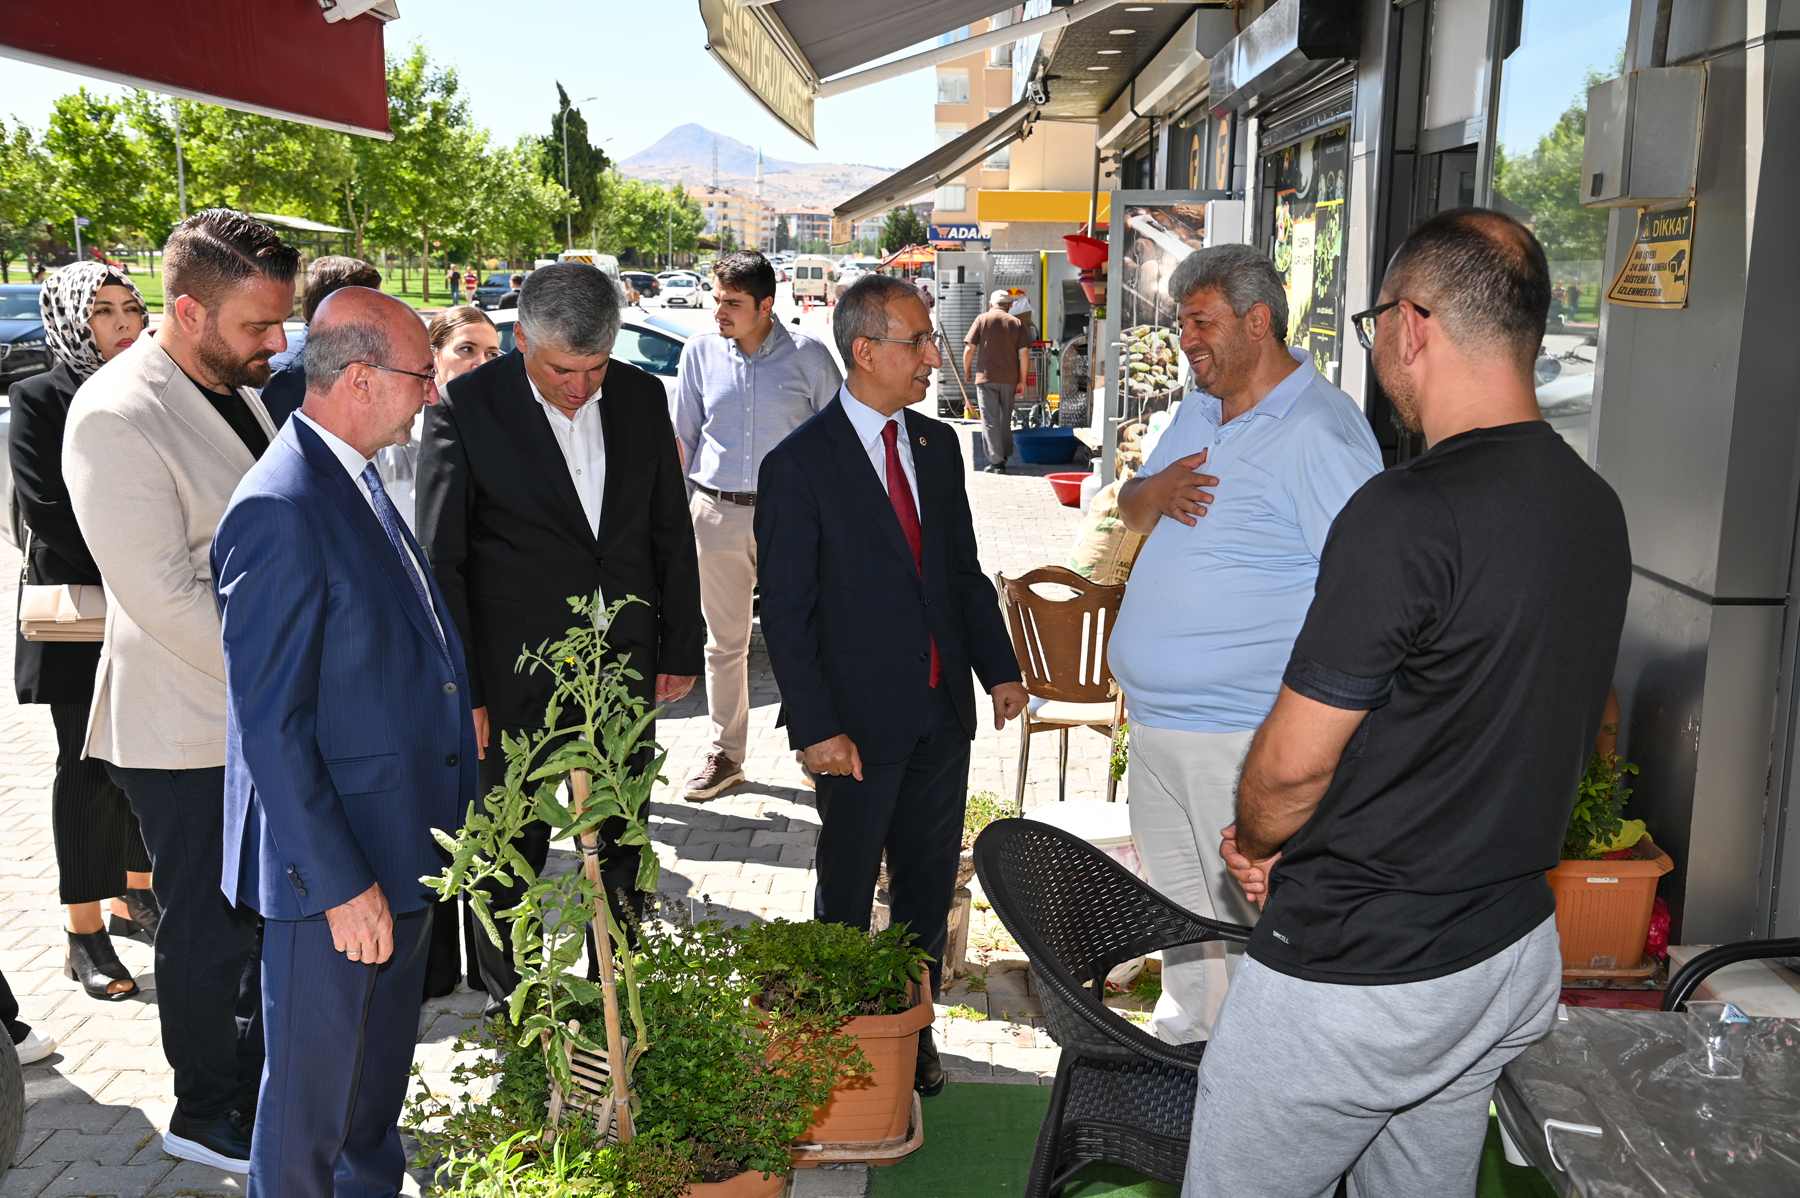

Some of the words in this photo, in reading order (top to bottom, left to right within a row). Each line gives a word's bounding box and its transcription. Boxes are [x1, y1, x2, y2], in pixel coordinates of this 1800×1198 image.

[1652, 215, 1689, 238] DİKKAT
[1634, 251, 1642, 260] BU
[1629, 263, 1638, 272] 24
[1638, 263, 1651, 272] SAAT
[1651, 262, 1667, 272] KAMERA
[1623, 274, 1647, 284] SİSTEMİ
[1647, 275, 1657, 284] İLE
[1617, 284, 1662, 297] İZLENMEKTEDİR
